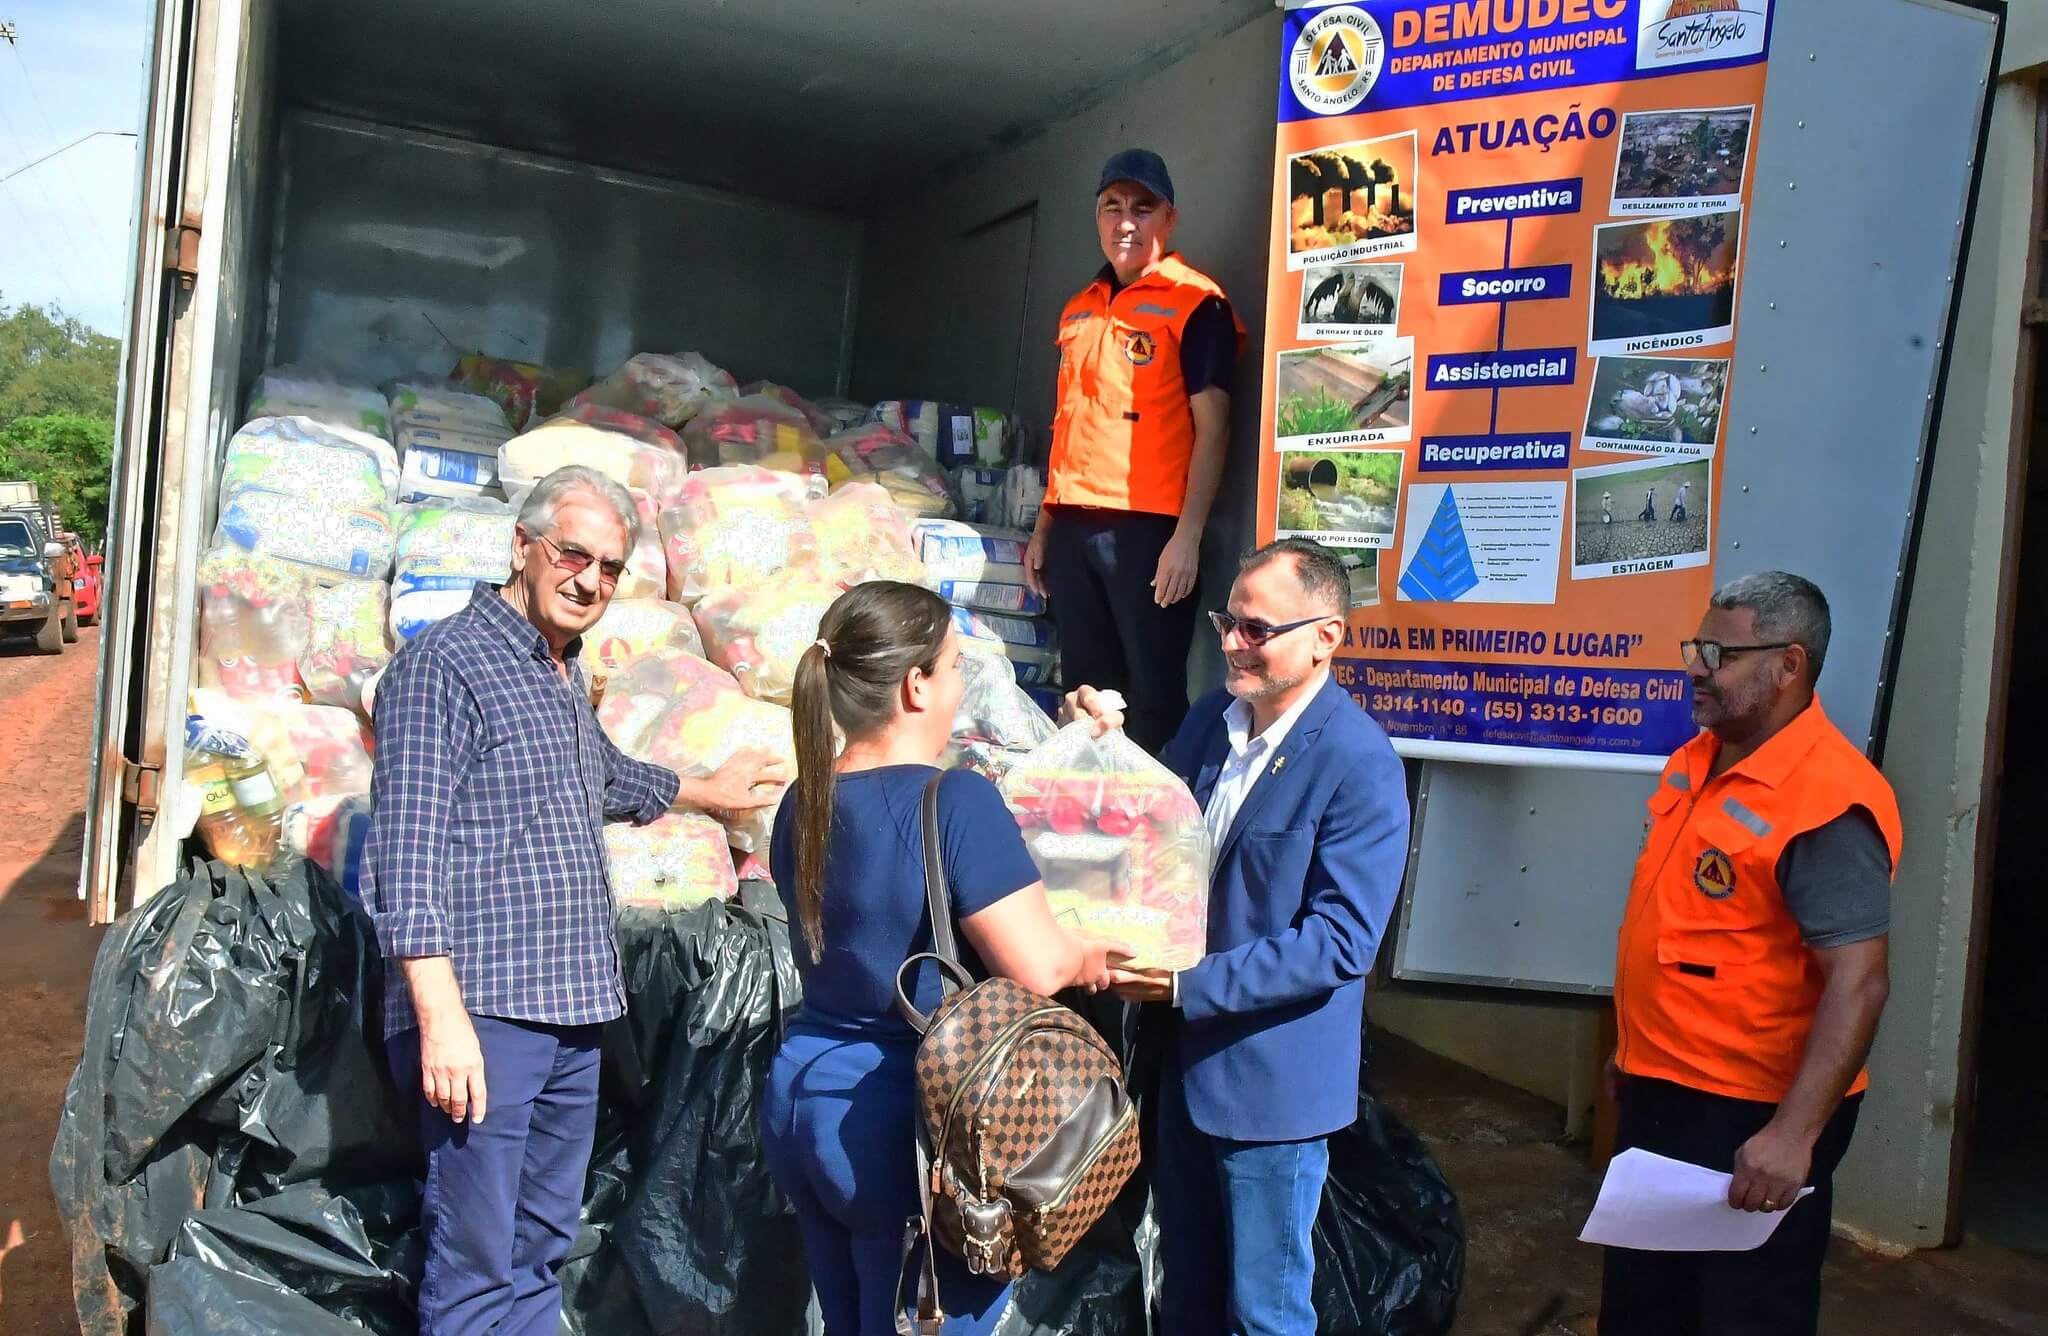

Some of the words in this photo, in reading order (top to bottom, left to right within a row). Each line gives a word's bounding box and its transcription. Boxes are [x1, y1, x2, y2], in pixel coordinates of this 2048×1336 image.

[1306, 15, 1342, 43] DEFESA
[1346, 15, 1370, 36] CIVIL
[1392, 0, 1628, 48] DEMUDEC
[1390, 41, 1524, 74] DEPARTAMENTO
[1528, 26, 1627, 56] MUNICIPAL
[1298, 79, 1321, 103] SANTO
[1361, 70, 1372, 84] RS
[1432, 74, 1455, 92] DE
[1459, 66, 1525, 89] DEFESA
[1529, 59, 1576, 80] CIVIL
[1431, 102, 1617, 157] ATUAÇÃO
[1456, 188, 1573, 216] Preventiva
[1622, 202, 1685, 210] DESLIZAMENTO
[1687, 201, 1698, 209] DE
[1701, 200, 1727, 208] TERRA
[1303, 249, 1348, 264] POLUIÇÃO
[1350, 241, 1405, 257] INDUSTRIAL
[1461, 276, 1546, 297] Socorro
[1626, 334, 1704, 351] INCÊNDIOS
[1434, 358, 1567, 382] Assistencial
[1308, 432, 1385, 446] ENXURRADA
[1595, 441, 1662, 453] CONTAMINAÇÃO
[1664, 446, 1675, 454] DA
[1425, 440, 1566, 465] Recuperativa
[1347, 536, 1381, 544] ESGOTO
[1612, 559, 1674, 574] ESTIAGEM
[1344, 627, 1354, 647] A
[1360, 627, 1402, 649] VIDA
[1407, 628, 1435, 650] EM
[1442, 629, 1547, 655] PRIMEIRO
[1366, 666, 1468, 692] Departamento
[1472, 671, 1550, 699] Municipal
[1554, 675, 1575, 696] de
[1580, 675, 1640, 699] Defesa
[1645, 678, 1684, 701] Civil
[1372, 694, 1465, 716] 3314-1140
[1484, 700, 1523, 722] (55)
[1530, 703, 1643, 725] 3313-1600
